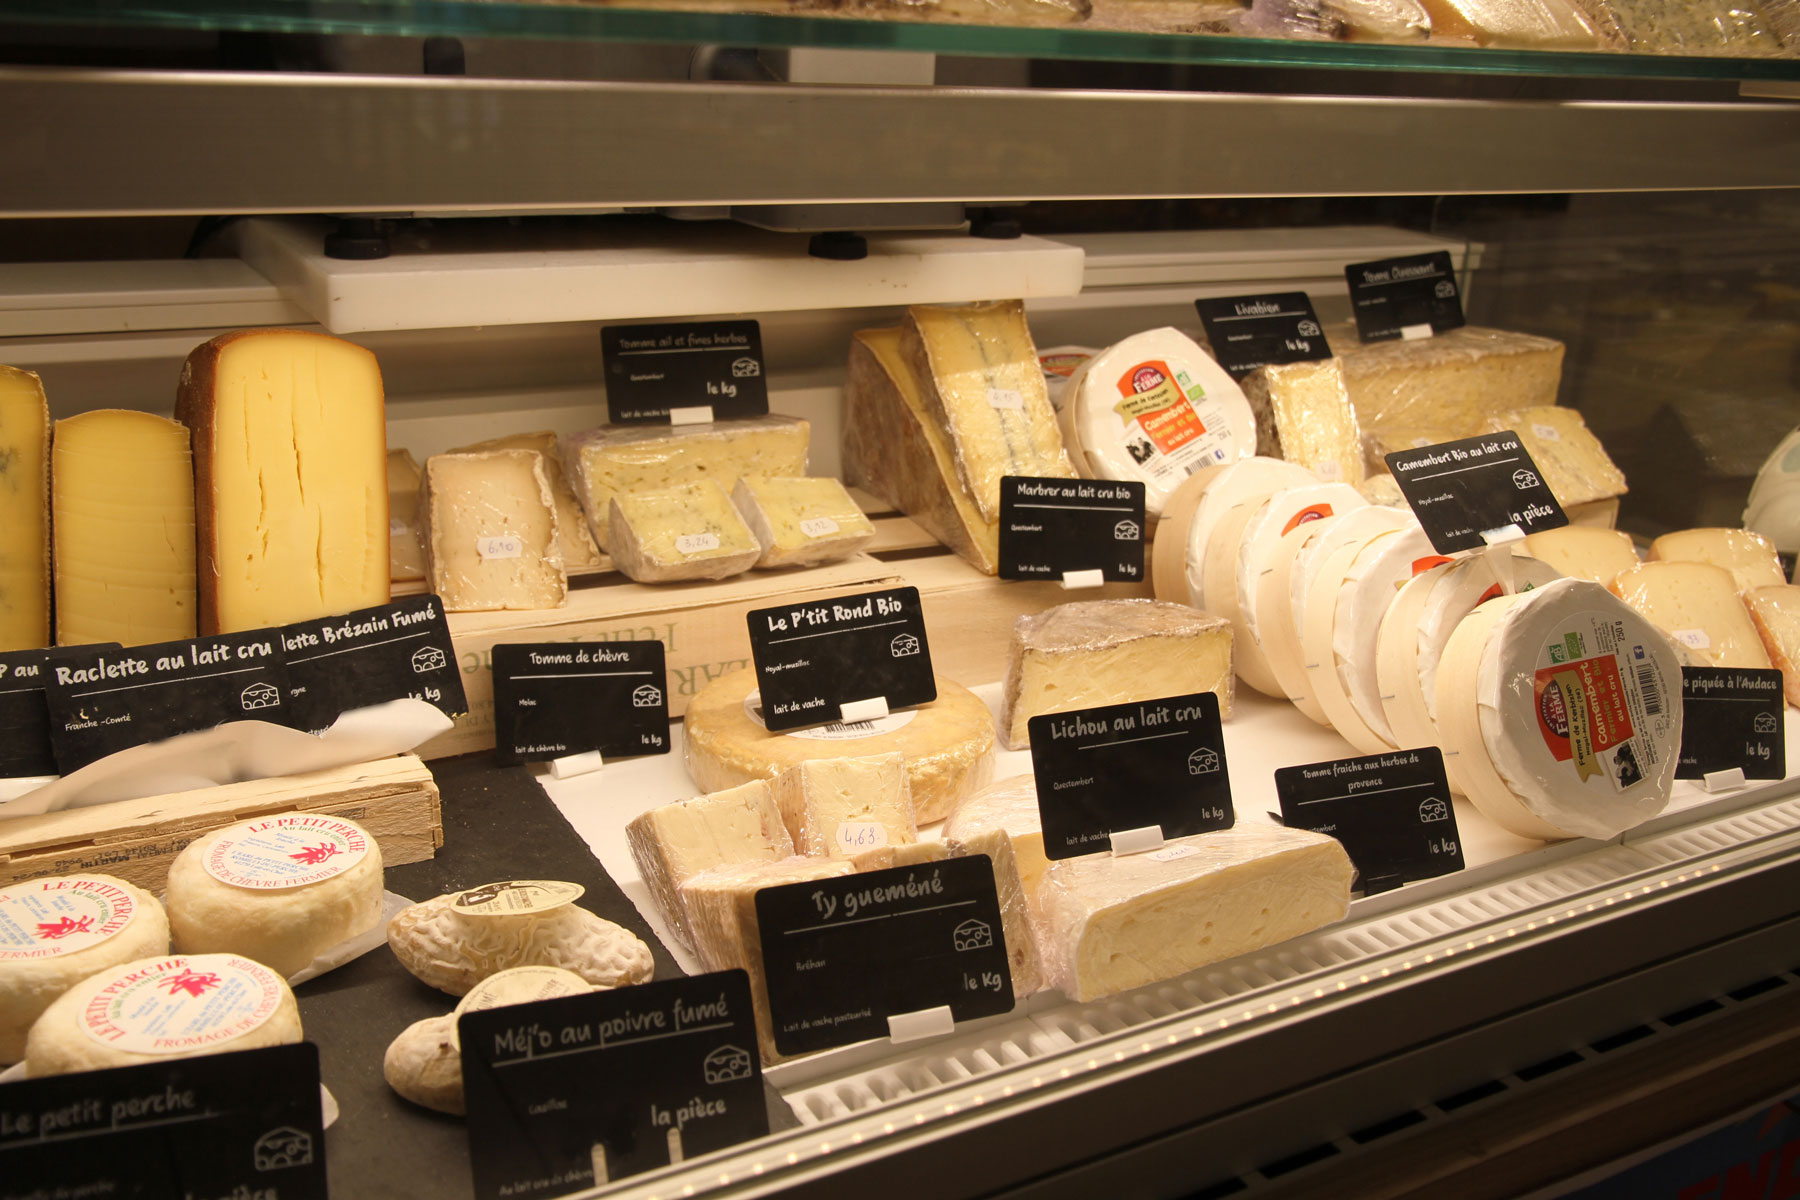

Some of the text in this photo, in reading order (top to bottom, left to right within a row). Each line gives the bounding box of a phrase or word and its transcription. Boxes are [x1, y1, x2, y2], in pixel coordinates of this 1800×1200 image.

[1234, 301, 1281, 316] Livabien
[620, 332, 748, 349] Tomme ail et fines herbes
[1284, 339, 1296, 351] le
[706, 380, 738, 397] le kg
[1133, 372, 1164, 394] FERME
[1144, 401, 1193, 431] Camembert
[1396, 440, 1518, 472] Camembert Bio au lait cru
[1017, 483, 1131, 499] Marbrer au lait cru bio
[1507, 503, 1554, 526] la pièce
[1118, 563, 1137, 576] le kg
[322, 618, 389, 644] Brézain
[391, 603, 437, 628] Fumé
[767, 596, 903, 632] Le P'tit Rond Bio
[1615, 627, 1626, 643] 250
[55, 641, 273, 686] Raclette au lait cru
[528, 648, 630, 665] Tomme de chèvre
[14, 664, 40, 678] au
[424, 686, 441, 701] kg
[1691, 675, 1725, 694] piquée
[1727, 675, 1734, 689] à
[1736, 674, 1777, 690] l'Audace
[773, 696, 826, 715] lait de vache
[1580, 661, 1608, 745] Camembert
[1607, 674, 1625, 723] au lait cru
[1550, 684, 1569, 735] FERME
[1597, 681, 1619, 744] Fermier et
[1050, 705, 1203, 740] Lichou au lait cru
[1573, 725, 1580, 737] de
[515, 743, 566, 754] lait de chèvre bio
[641, 734, 662, 747] le kg
[1575, 739, 1586, 766] Ferme
[1745, 741, 1771, 761] le kg
[1302, 768, 1332, 781] Tomme
[1363, 761, 1380, 772] aux
[1380, 755, 1409, 769] herbes
[1408, 752, 1420, 764] de
[1347, 776, 1384, 794] provence
[1201, 805, 1225, 821] le kg
[248, 817, 366, 854] LE PETIT PERCHE
[1065, 830, 1108, 846] lait de vache
[210, 840, 234, 872] FROMAGE
[1427, 837, 1457, 857] le kg
[216, 869, 235, 880] DE
[285, 866, 342, 887] FERMIER
[811, 868, 944, 919] Ty gueméné
[43, 880, 133, 937] LE PETIT PERCHE
[102, 958, 189, 994] PERCHE
[963, 972, 978, 991] le
[560, 1024, 592, 1045] au
[598, 1008, 667, 1049] poivre
[673, 992, 730, 1032] fumé
[783, 1021, 799, 1033] Lait
[800, 1019, 812, 1031] de
[811, 1014, 833, 1029] vache
[94, 1024, 127, 1043] LE
[153, 1027, 237, 1048] FROMAGE
[236, 1017, 256, 1031] DE
[0, 1084, 197, 1140] Le petit perche
[651, 1095, 727, 1132] la pièce
